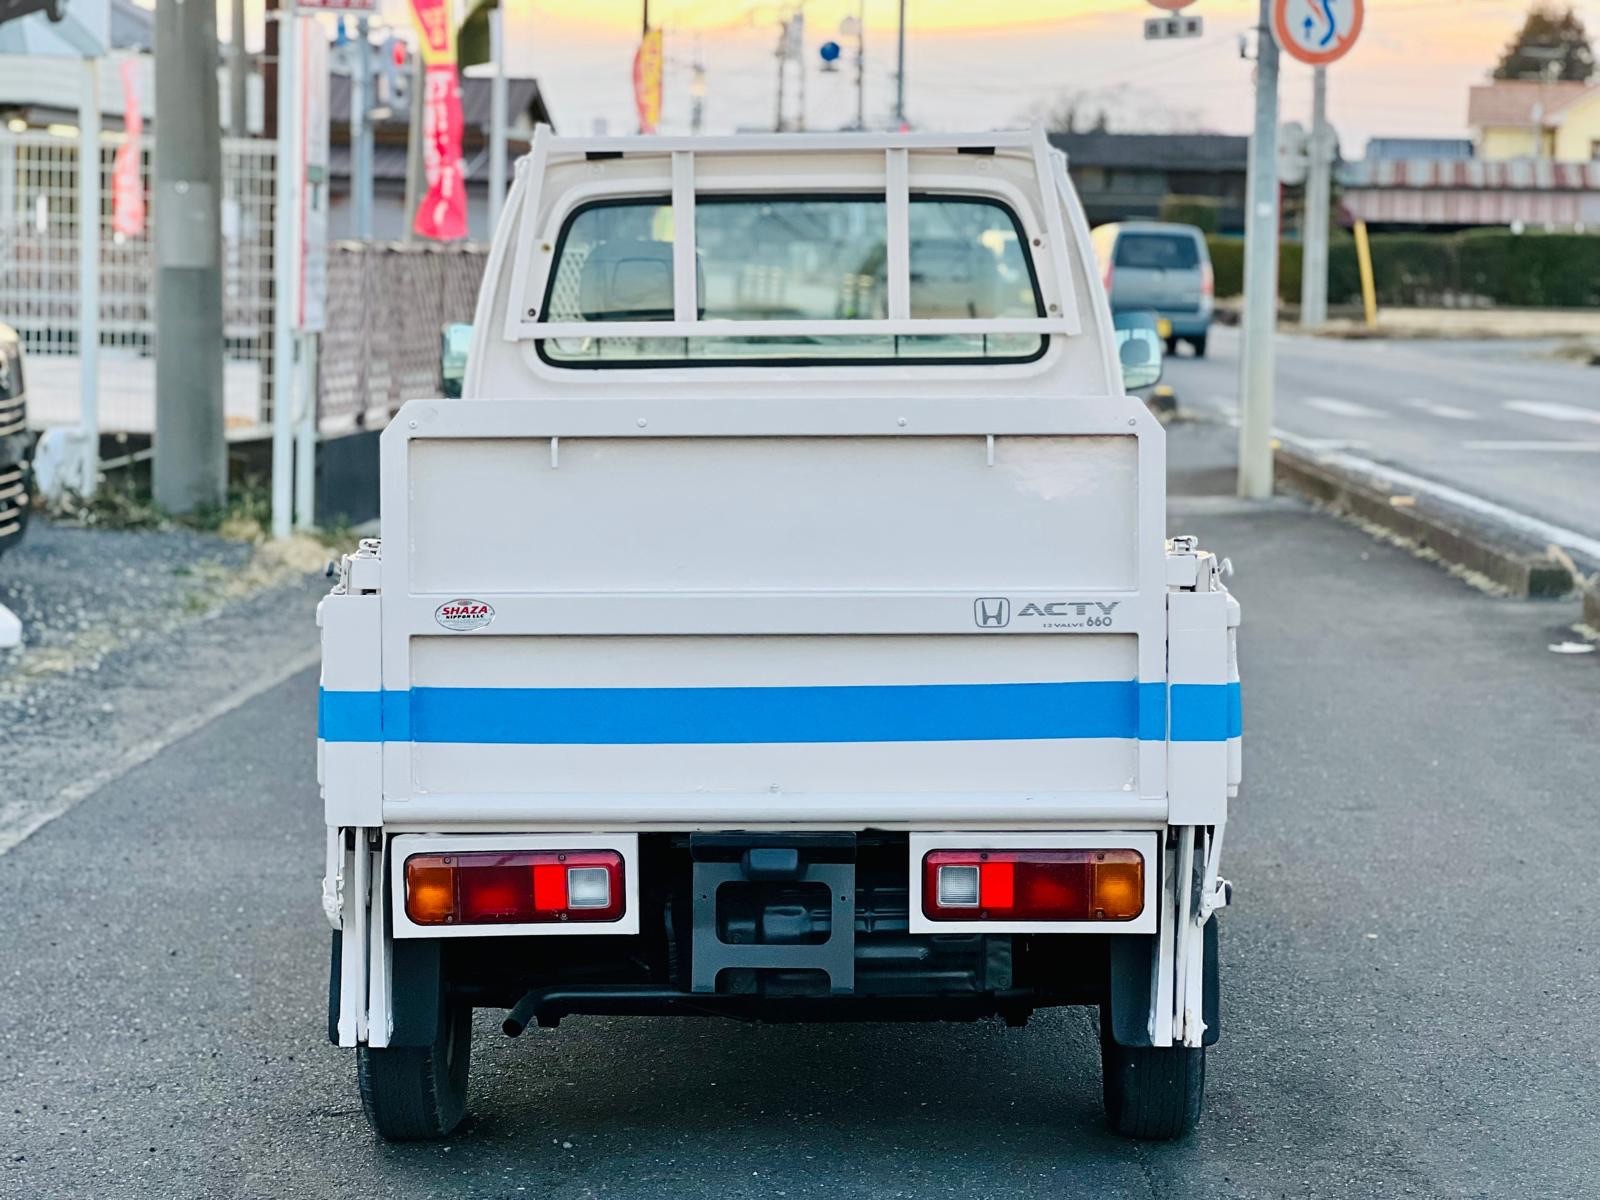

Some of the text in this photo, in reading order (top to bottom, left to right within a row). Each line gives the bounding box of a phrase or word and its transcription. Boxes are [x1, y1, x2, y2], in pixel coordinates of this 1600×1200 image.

[442, 606, 488, 615] SHAZA
[1017, 601, 1121, 616] ACTY
[1086, 616, 1113, 627] 660
